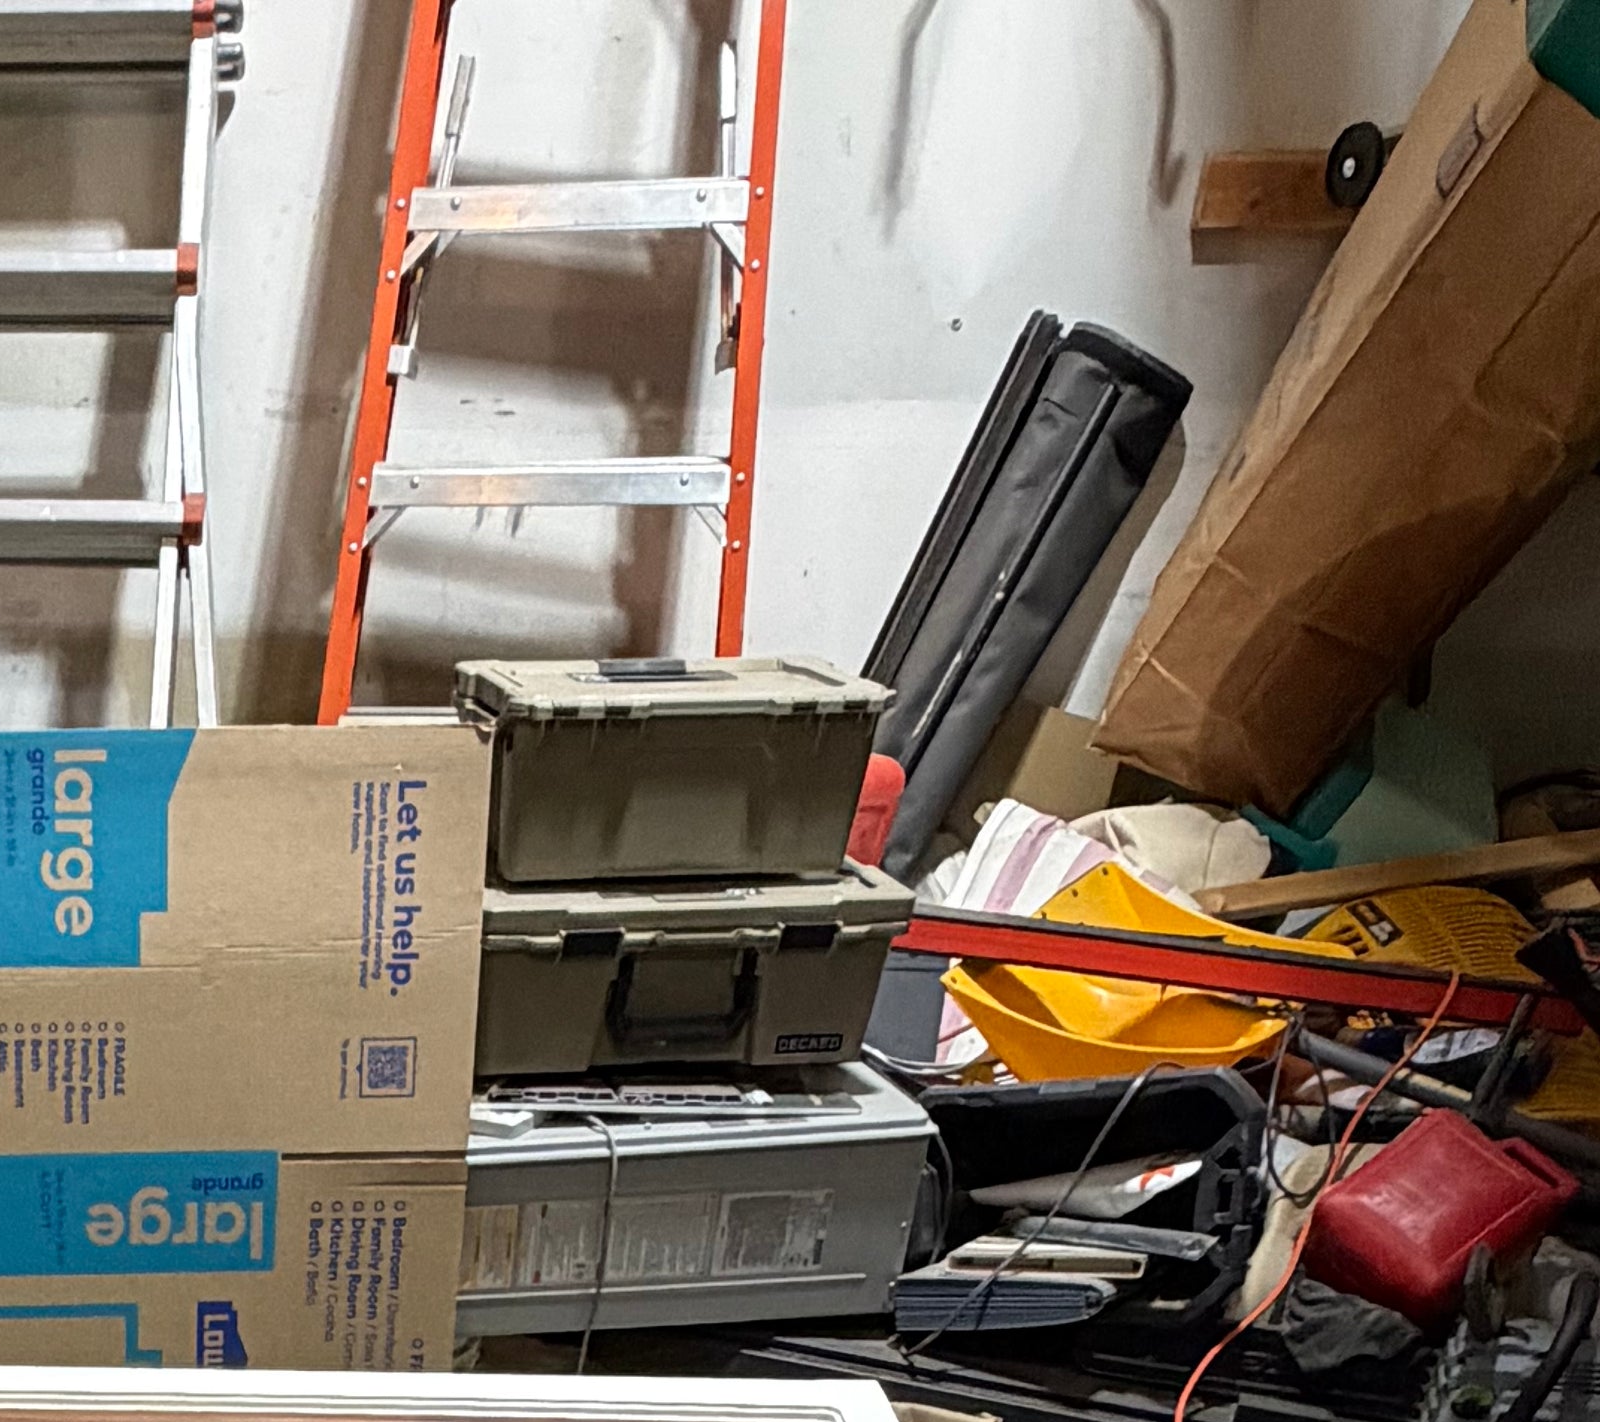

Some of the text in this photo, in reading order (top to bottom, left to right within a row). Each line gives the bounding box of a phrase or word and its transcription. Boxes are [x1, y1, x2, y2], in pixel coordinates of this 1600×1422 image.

[26, 747, 49, 836] grande
[39, 749, 107, 936] large
[364, 839, 374, 865] and
[378, 835, 390, 860] find
[385, 780, 427, 997] Let us help.
[14, 1040, 25, 1108] Basement
[31, 1039, 42, 1072] Bath
[48, 1039, 59, 1092] Kitchen
[62, 1038, 75, 1082] Dining
[80, 1038, 92, 1082] Family
[97, 1038, 108, 1099] Bedroom
[113, 1037, 126, 1096] FRAGILE
[190, 1172, 264, 1195] grande
[83, 1186, 264, 1261] large
[308, 1218, 323, 1258] Bath
[327, 1218, 344, 1281] Kitchen
[346, 1218, 365, 1270] Dining
[368, 1218, 386, 1271] Family
[389, 1217, 407, 1290] Bedroom
[346, 1274, 362, 1319] Room
[366, 1274, 381, 1320] Room
